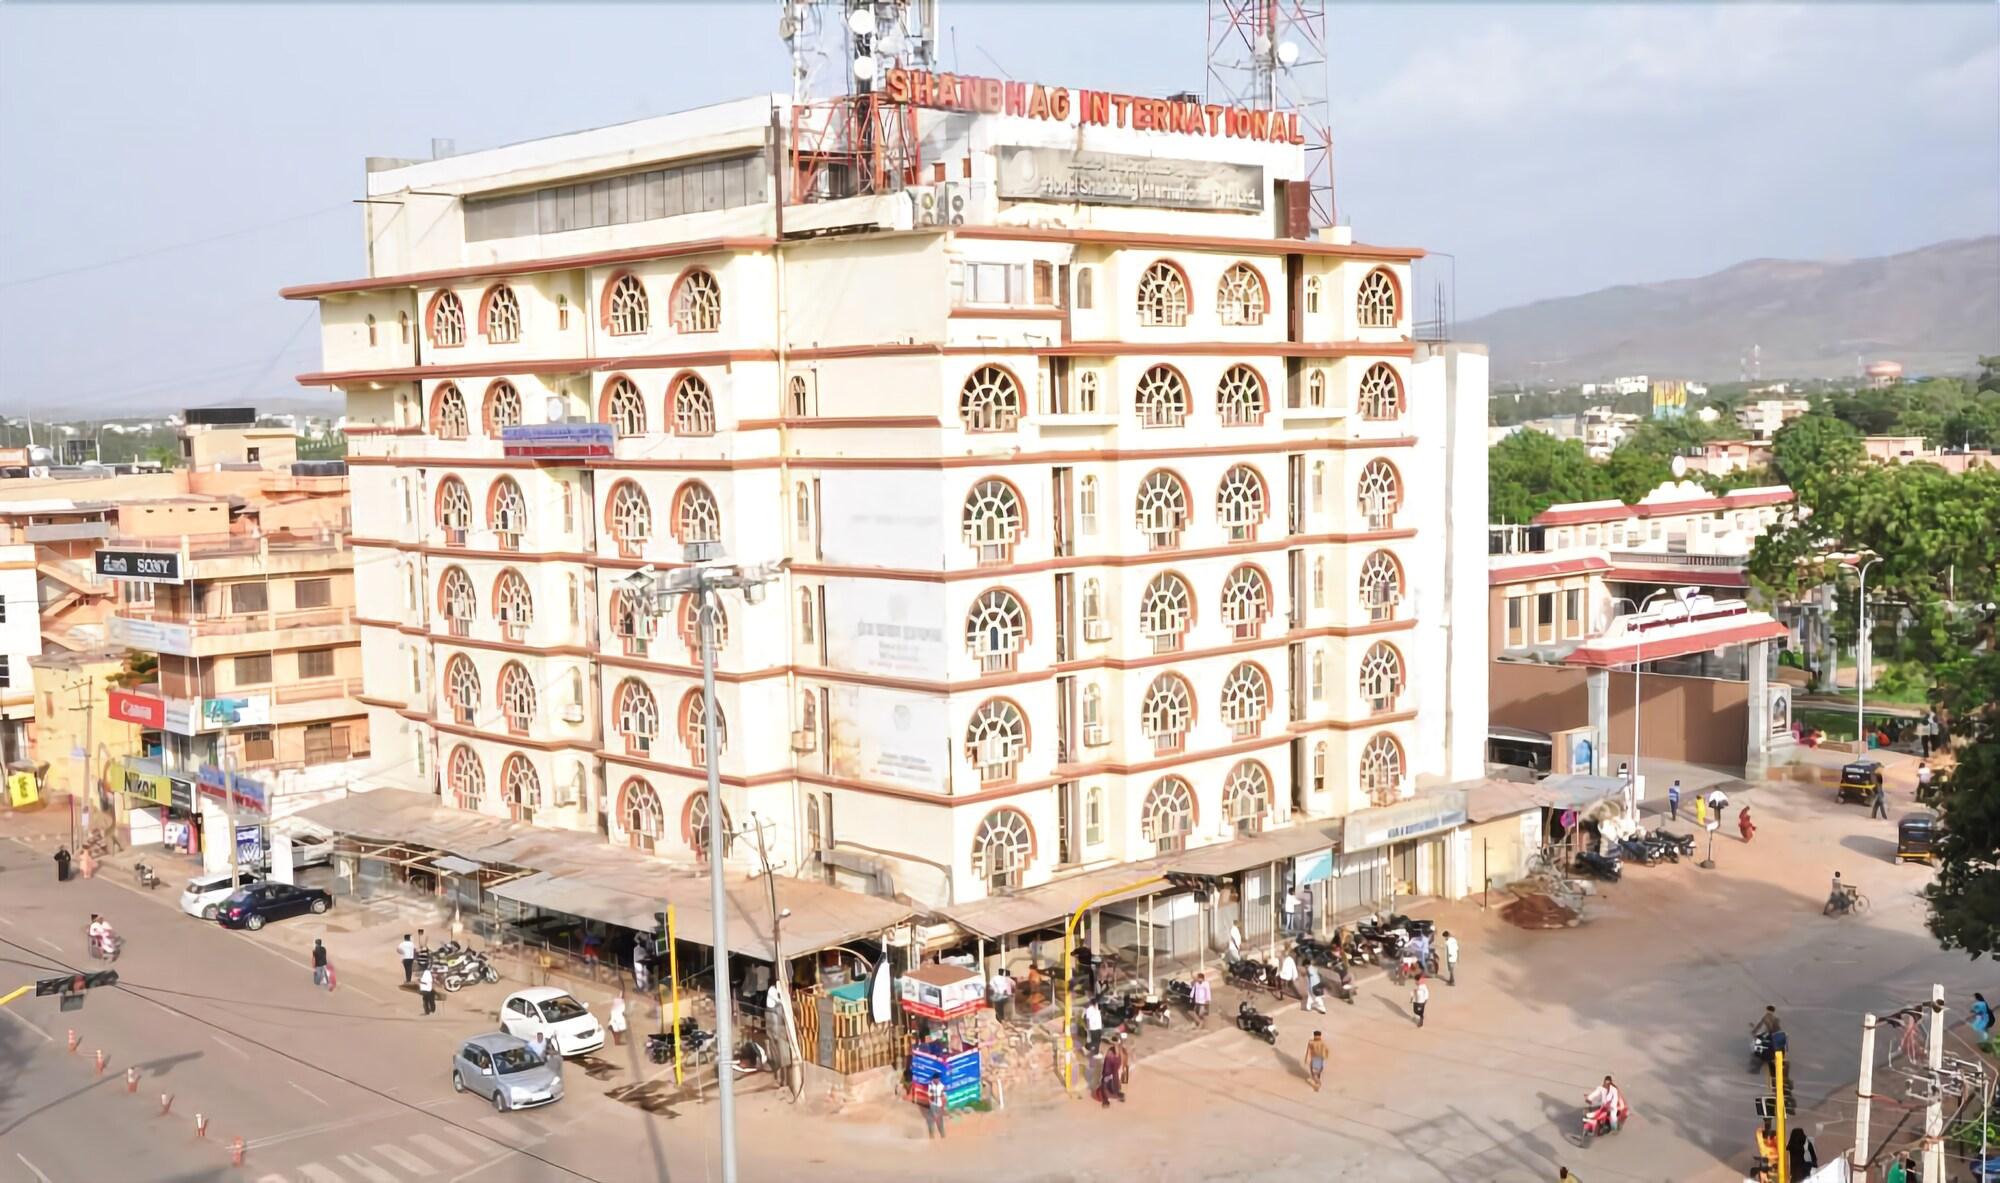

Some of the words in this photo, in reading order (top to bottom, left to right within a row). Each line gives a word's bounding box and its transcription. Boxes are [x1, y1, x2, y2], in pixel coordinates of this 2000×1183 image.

[887, 68, 1070, 121] SHANBHAG
[1079, 89, 1305, 145] INTERNATIONAL
[137, 558, 169, 574] SONY
[120, 699, 152, 721] Can
